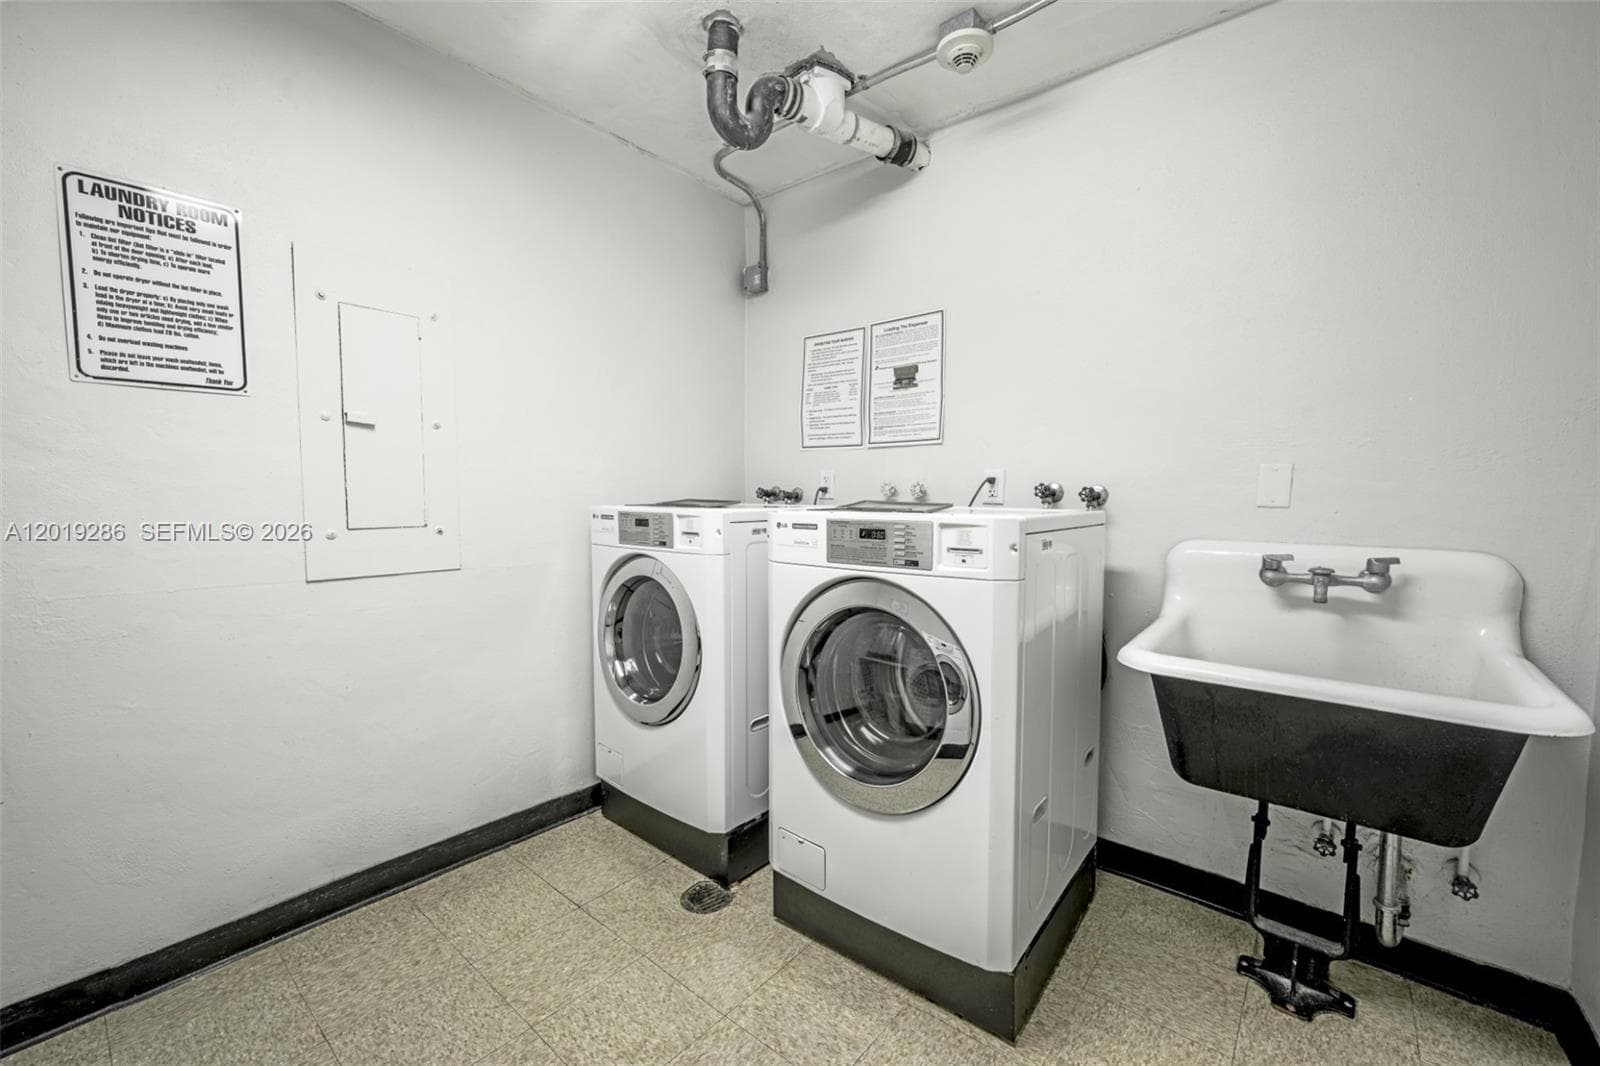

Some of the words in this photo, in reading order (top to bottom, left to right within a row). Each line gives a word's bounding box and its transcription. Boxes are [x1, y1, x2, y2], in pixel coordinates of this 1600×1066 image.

[77, 178, 169, 213] LAUNDRY
[176, 202, 228, 228] ROOM
[118, 204, 197, 234] NOTICES
